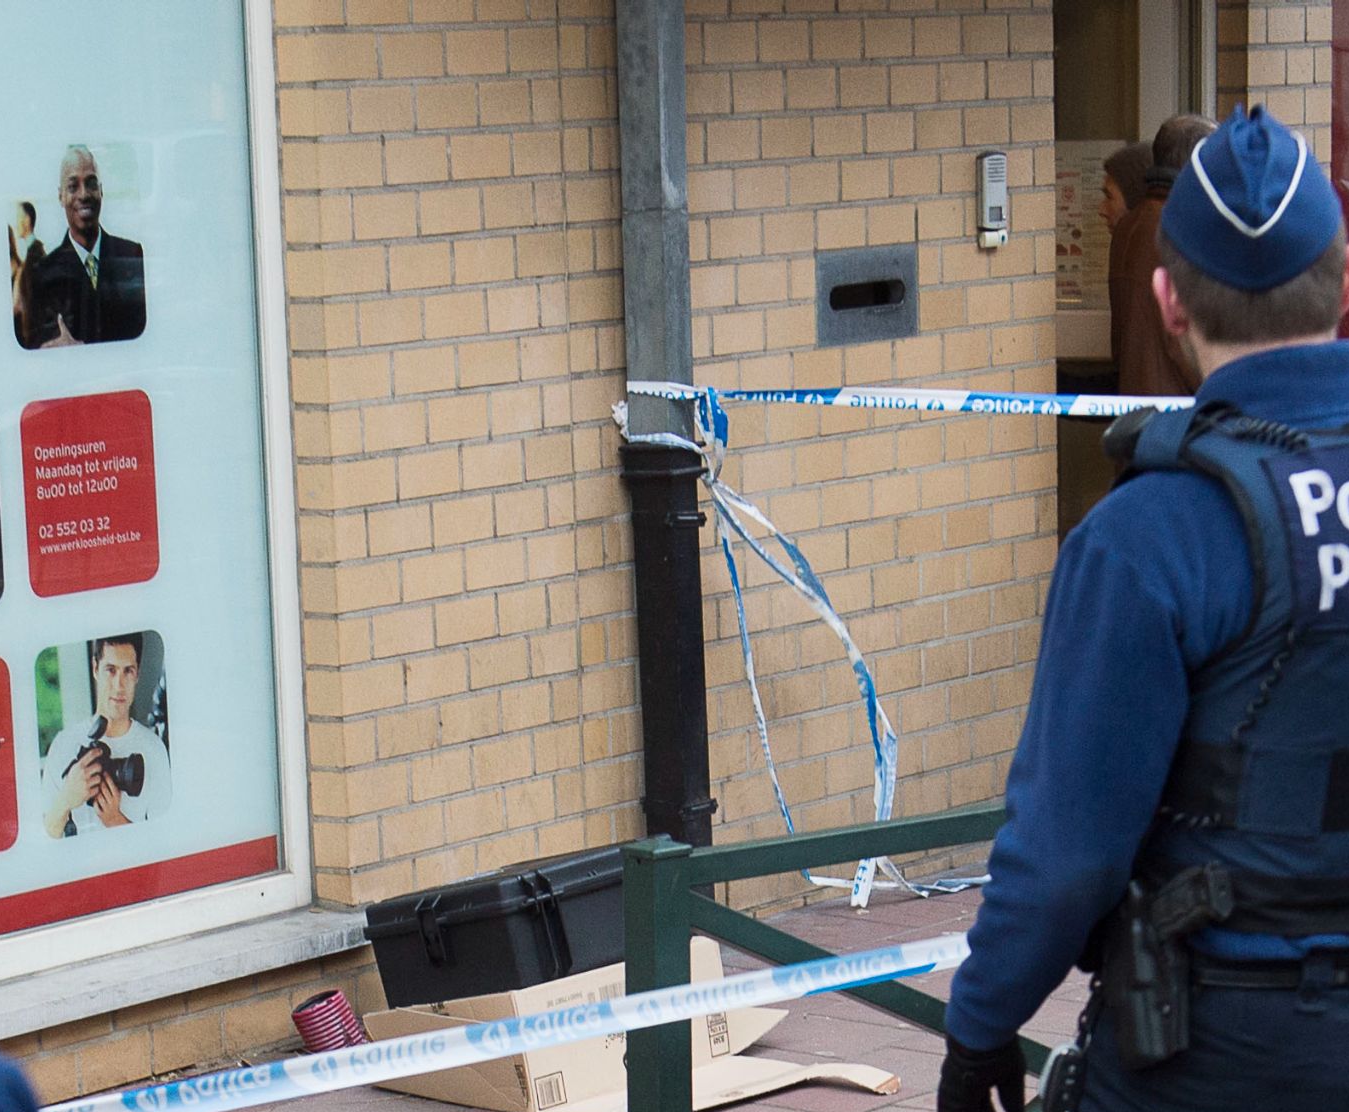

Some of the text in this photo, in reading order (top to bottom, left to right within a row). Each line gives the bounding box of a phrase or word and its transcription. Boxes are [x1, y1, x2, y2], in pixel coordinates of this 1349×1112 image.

[34, 441, 106, 461] Openingsuren
[35, 456, 138, 480] Maandag tot vrijdag
[36, 476, 118, 500] 8u00 tot 12u00
[39, 516, 110, 539] 02 552 03 32
